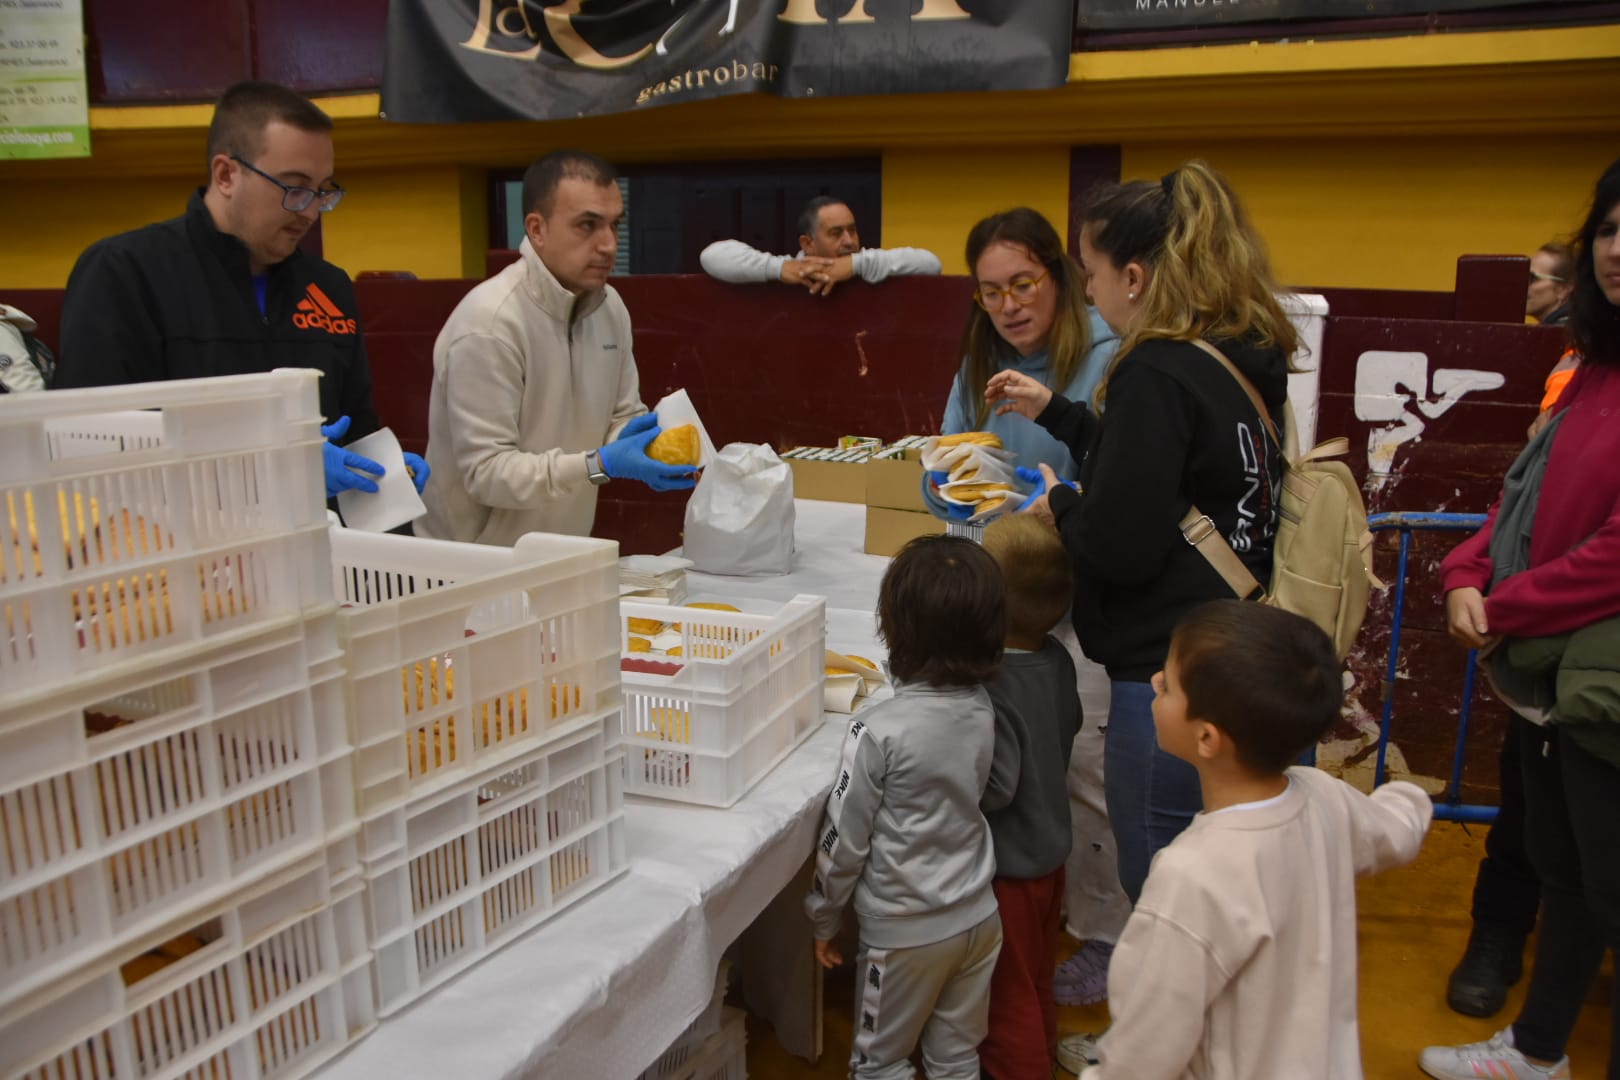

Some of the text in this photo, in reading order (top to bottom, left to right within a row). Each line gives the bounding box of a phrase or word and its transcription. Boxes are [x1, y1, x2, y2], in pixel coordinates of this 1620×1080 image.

[1135, 0, 1240, 10] MANU
[635, 59, 778, 105] gastrobar
[292, 312, 356, 335] addas
[834, 769, 850, 800] NIKE
